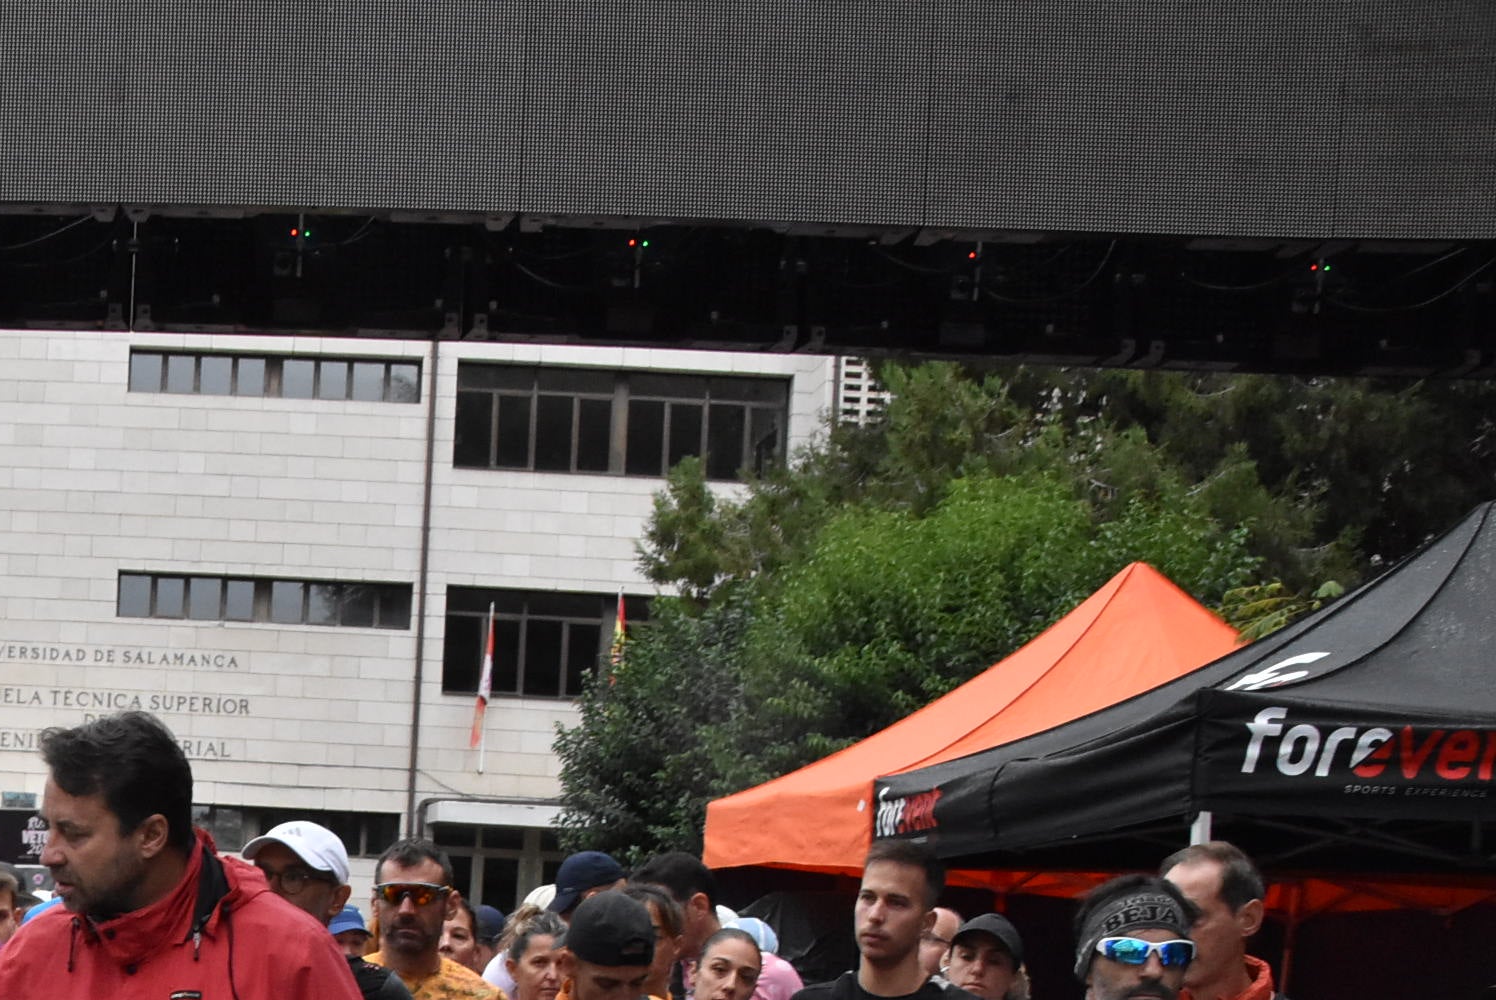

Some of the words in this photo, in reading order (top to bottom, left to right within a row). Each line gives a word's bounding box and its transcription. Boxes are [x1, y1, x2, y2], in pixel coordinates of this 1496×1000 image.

[94, 650, 115, 664] DE
[123, 650, 238, 668] SALAMANCA
[149, 694, 250, 715] SUPERIOR
[1343, 784, 1396, 795] SPORTS
[1404, 786, 1488, 798] EXPERIENCE
